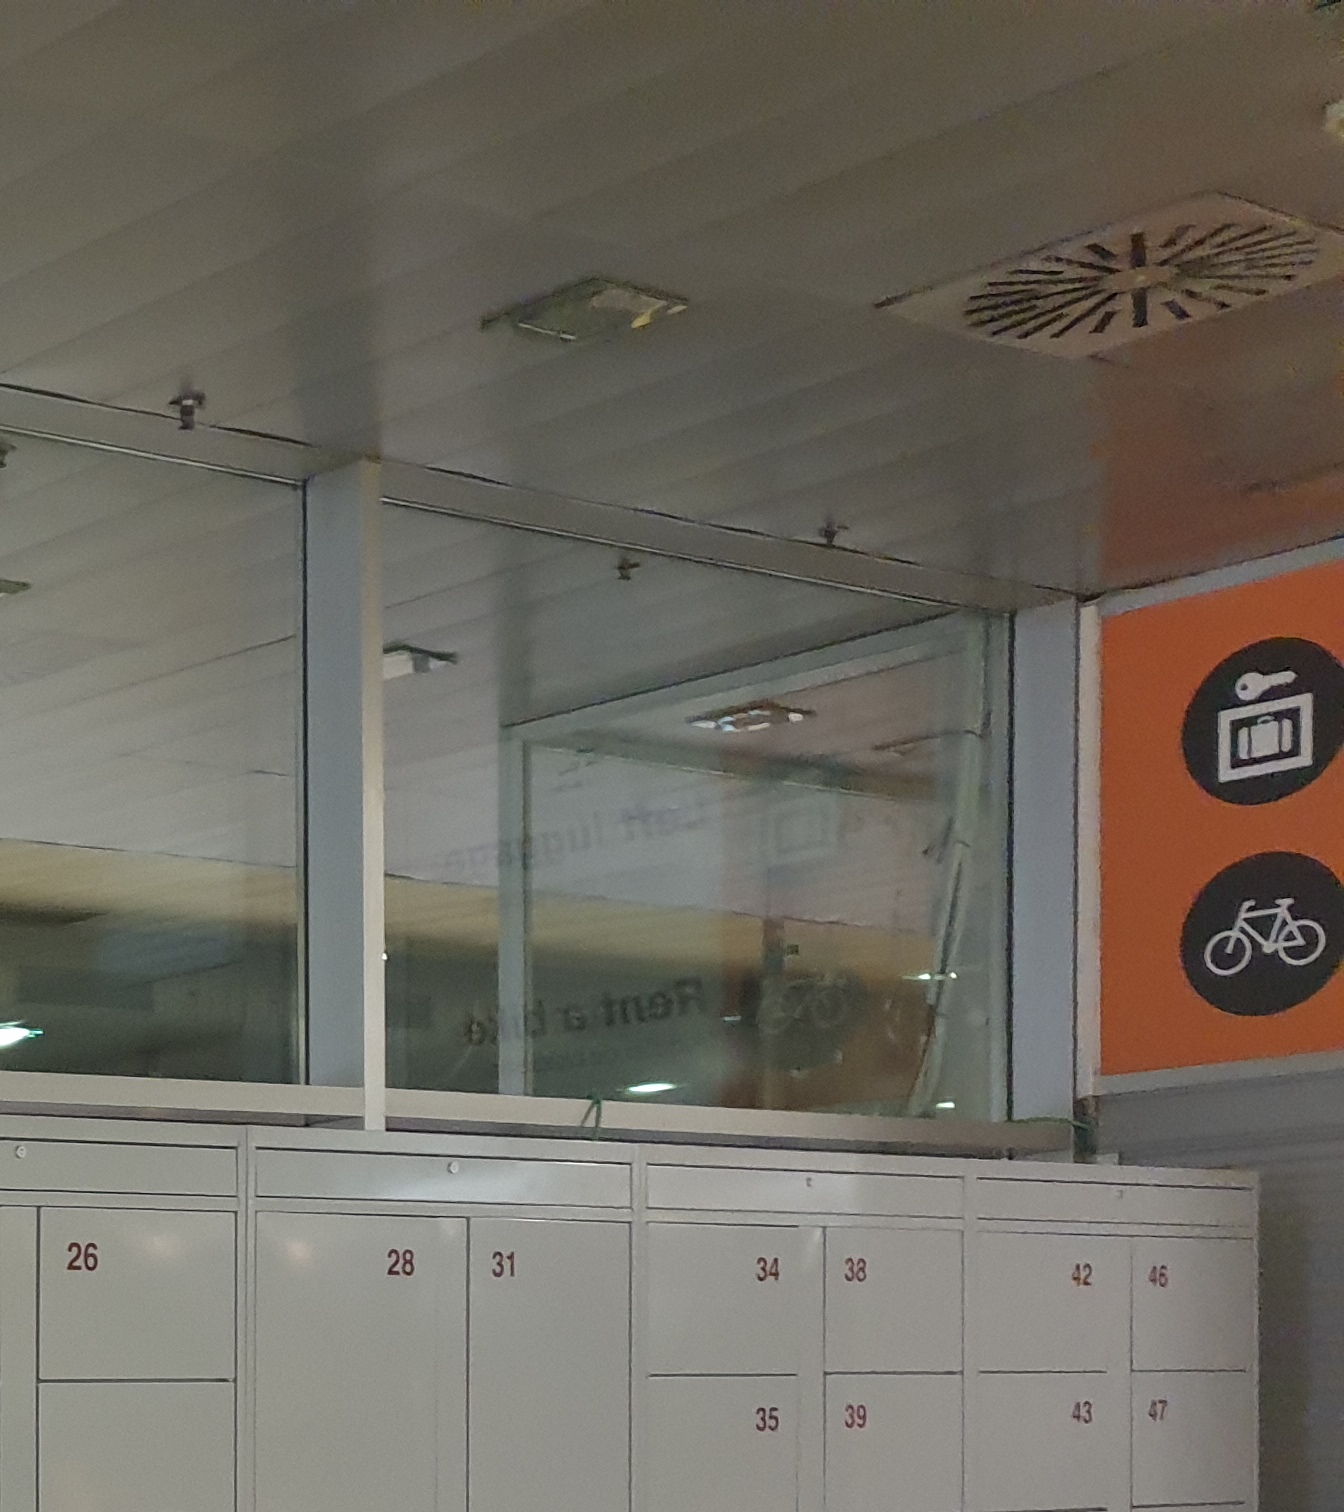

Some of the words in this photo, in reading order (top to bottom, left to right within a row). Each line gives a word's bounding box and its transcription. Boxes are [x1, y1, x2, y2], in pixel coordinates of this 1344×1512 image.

[66, 1242, 99, 1272] 26
[386, 1249, 415, 1277] 28
[491, 1251, 516, 1278] 31
[756, 1257, 780, 1283] 34
[844, 1258, 867, 1283] 38
[1071, 1263, 1093, 1287] 42
[1148, 1265, 1169, 1288] 46
[755, 1407, 780, 1432] 35
[844, 1404, 868, 1429] 39
[1071, 1401, 1093, 1425] 43
[1147, 1399, 1169, 1422] 47
